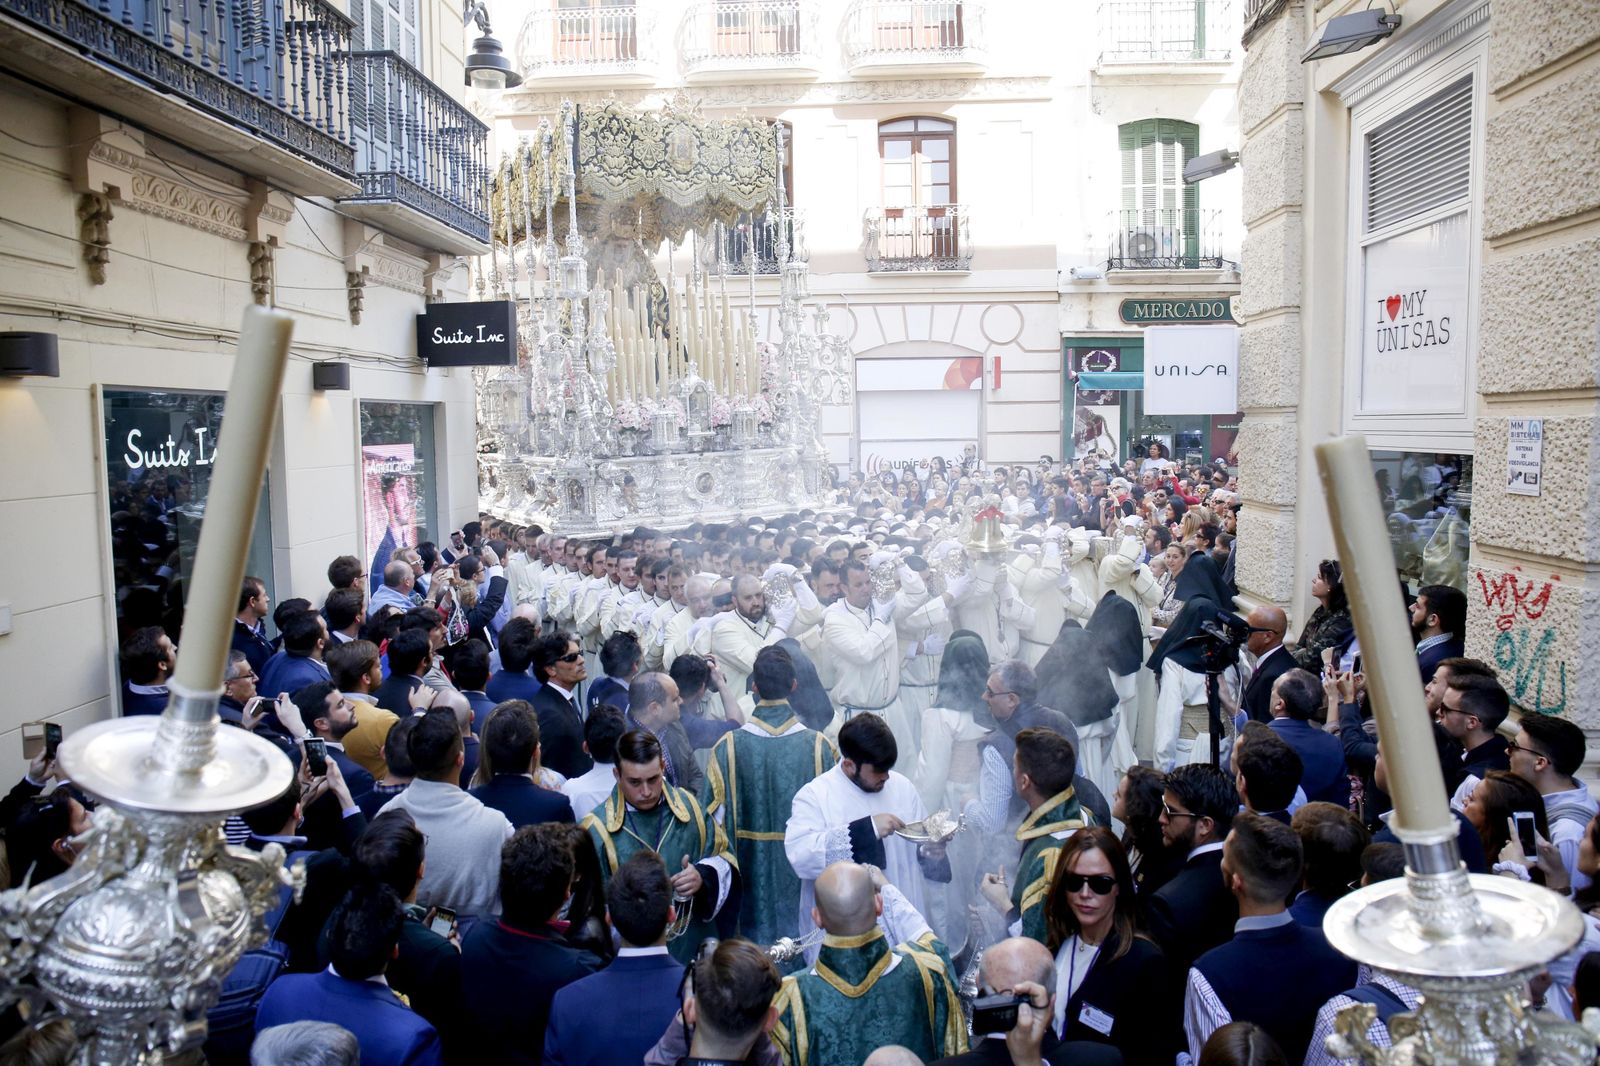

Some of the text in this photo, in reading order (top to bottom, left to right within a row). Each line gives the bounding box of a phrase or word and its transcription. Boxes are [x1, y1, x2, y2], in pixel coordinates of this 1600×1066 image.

[1133, 301, 1225, 318] MERCADO
[1377, 289, 1427, 324] I MY
[431, 324, 505, 344] Suits Inc
[1377, 316, 1450, 353] UNISAS
[1154, 364, 1227, 376] UNISA
[1510, 421, 1524, 430] MM
[1510, 431, 1540, 439] SISTEMAS
[123, 428, 191, 469] Suits
